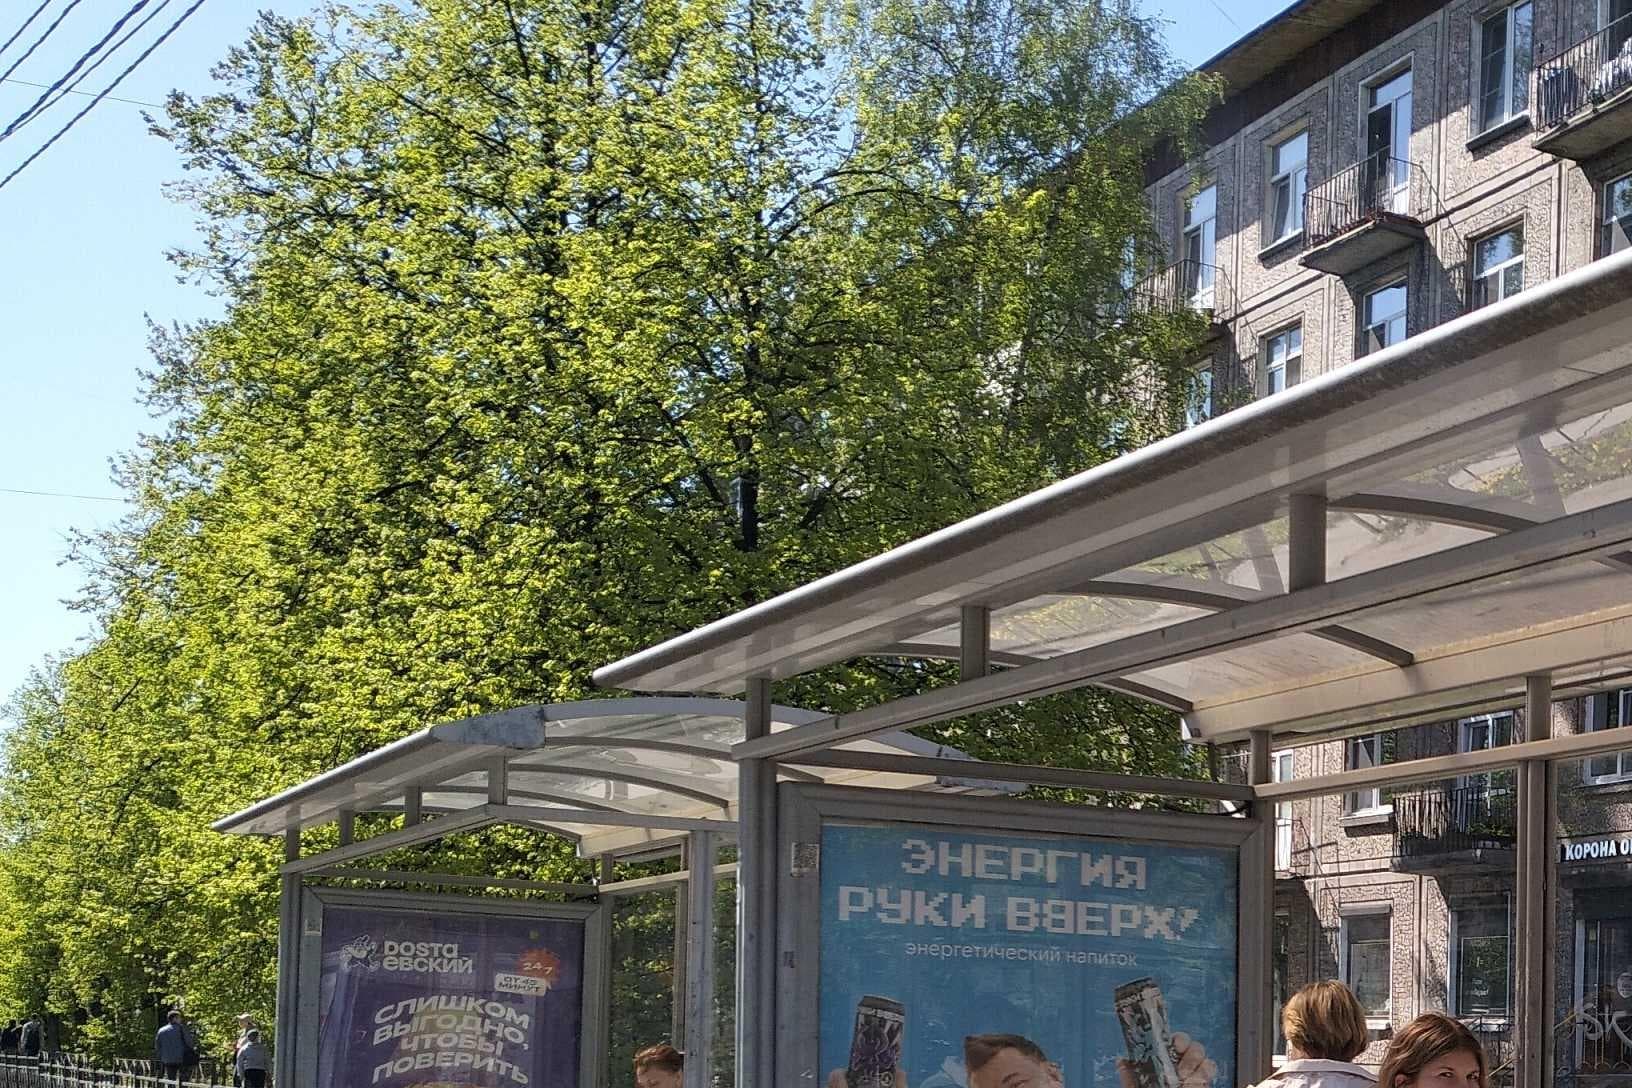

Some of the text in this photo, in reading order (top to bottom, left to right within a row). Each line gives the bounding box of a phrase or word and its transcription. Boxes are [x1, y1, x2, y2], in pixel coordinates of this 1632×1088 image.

[902, 839, 1147, 890] ЭНЕРГИЯ
[1565, 840, 1617, 860] КОРОНА
[838, 885, 986, 929] РУКИ
[905, 942, 1137, 967] энергетический напиток
[374, 995, 530, 1029] СЛИШКОМ
[373, 1014, 529, 1050] ВЫГОДНО,
[400, 1033, 504, 1056] ЧТОБЫ
[372, 1051, 529, 1084] ПОВЕРИТЬ
